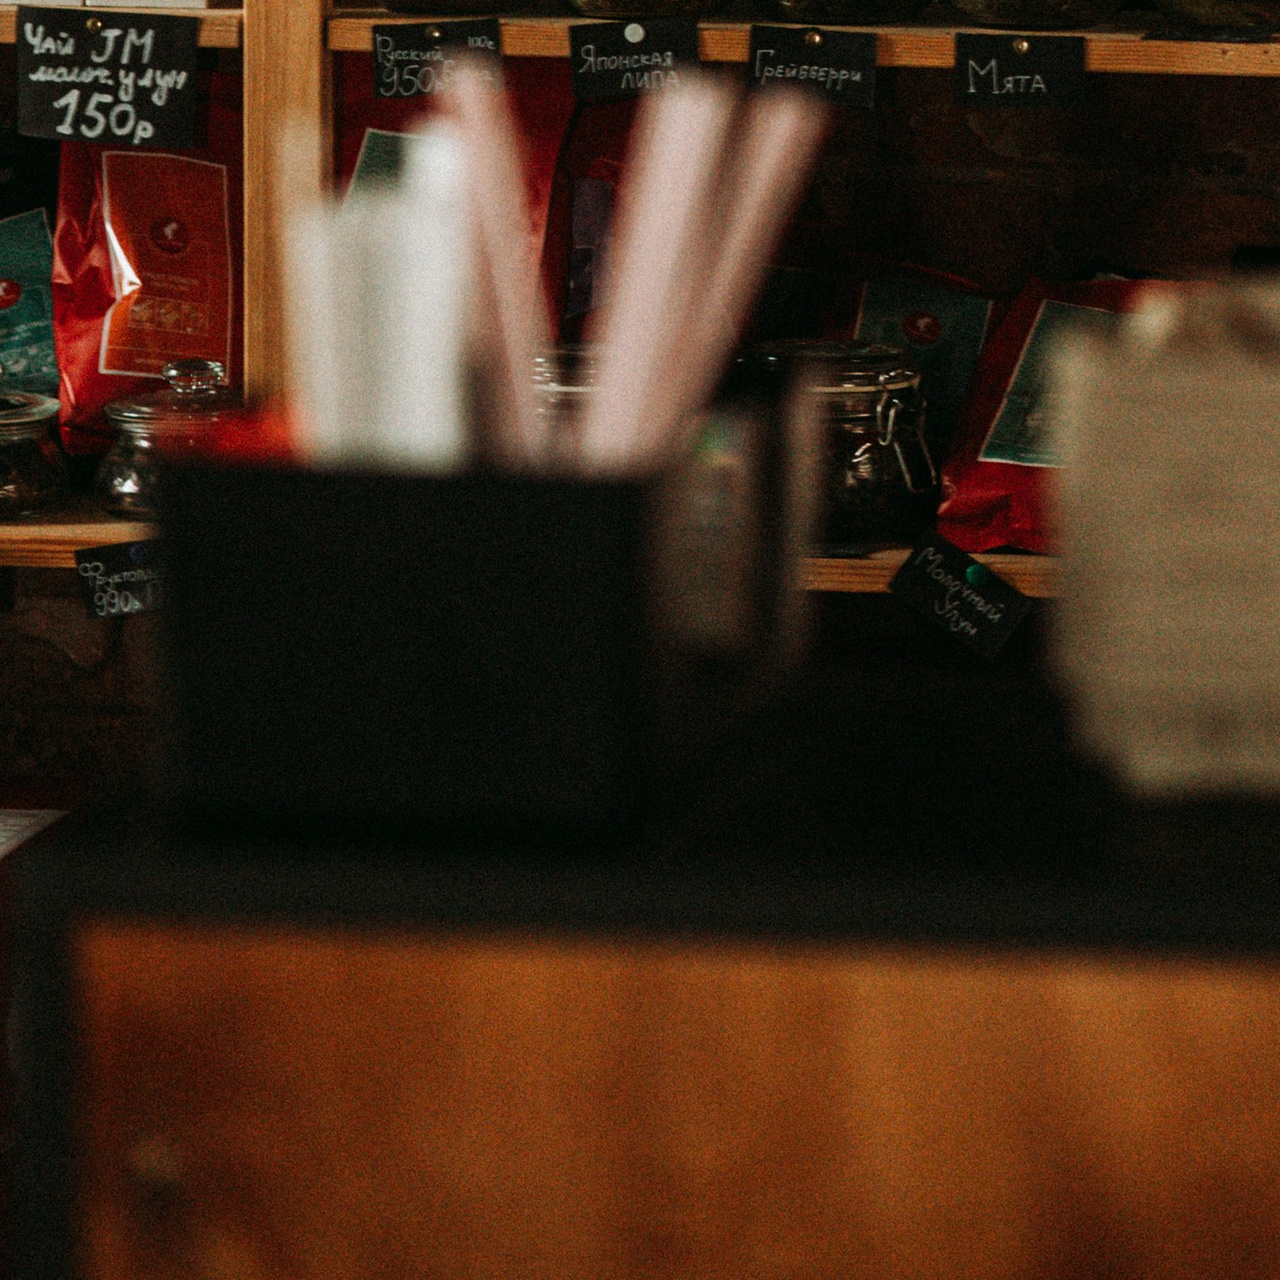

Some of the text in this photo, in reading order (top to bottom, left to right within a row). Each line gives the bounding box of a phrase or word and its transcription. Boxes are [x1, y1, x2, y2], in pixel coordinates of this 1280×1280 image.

[24, 22, 155, 64] Чай JM
[579, 45, 673, 73] Японская
[967, 59, 1046, 94] Мята
